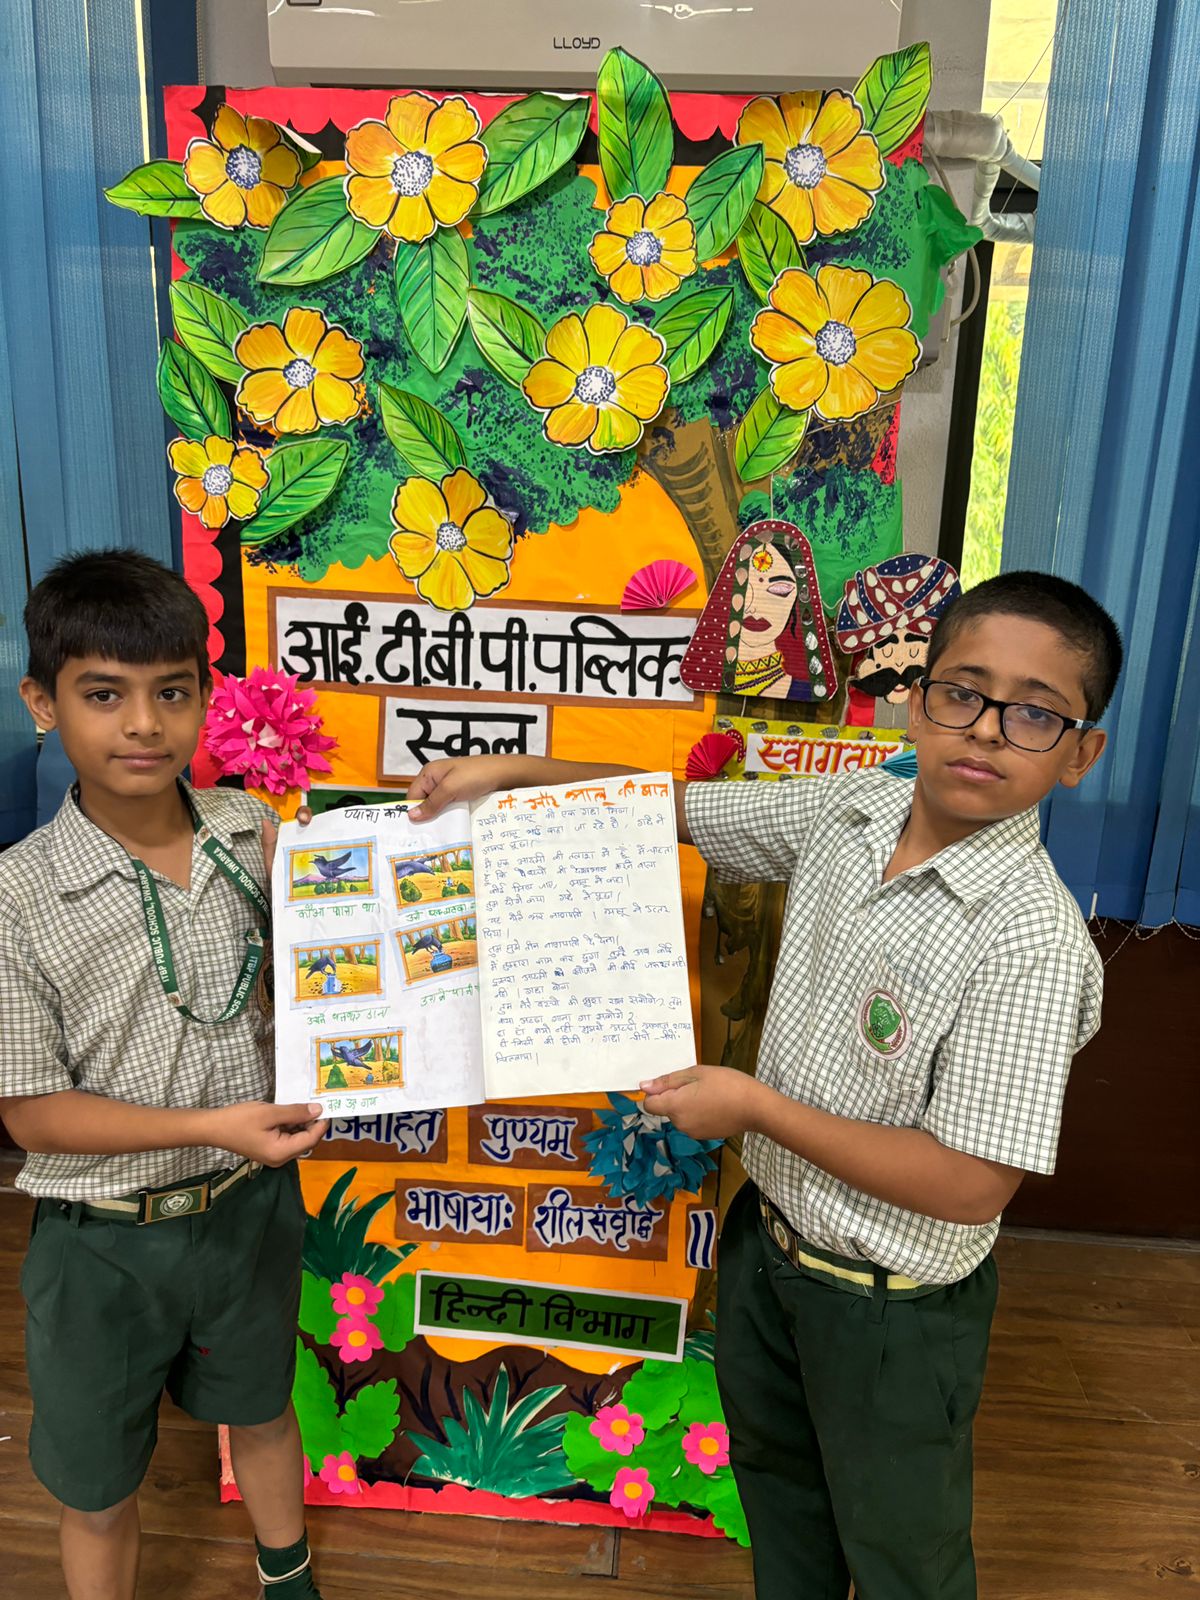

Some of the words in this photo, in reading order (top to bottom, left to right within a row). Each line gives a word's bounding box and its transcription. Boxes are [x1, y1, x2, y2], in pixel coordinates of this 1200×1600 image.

[553, 37, 601, 49] LLOYD
[213, 846, 240, 874] DWARKA
[138, 869, 153, 902] DWARKA
[146, 902, 160, 937] SCHOOL,
[151, 936, 166, 965] PUBLIC
[246, 955, 258, 974] ITBP
[158, 965, 170, 983] ITBP
[236, 973, 252, 1000] PUBLIC
[429, 1282, 533, 1328] हिन्दी
[541, 1293, 657, 1344] विभाग
